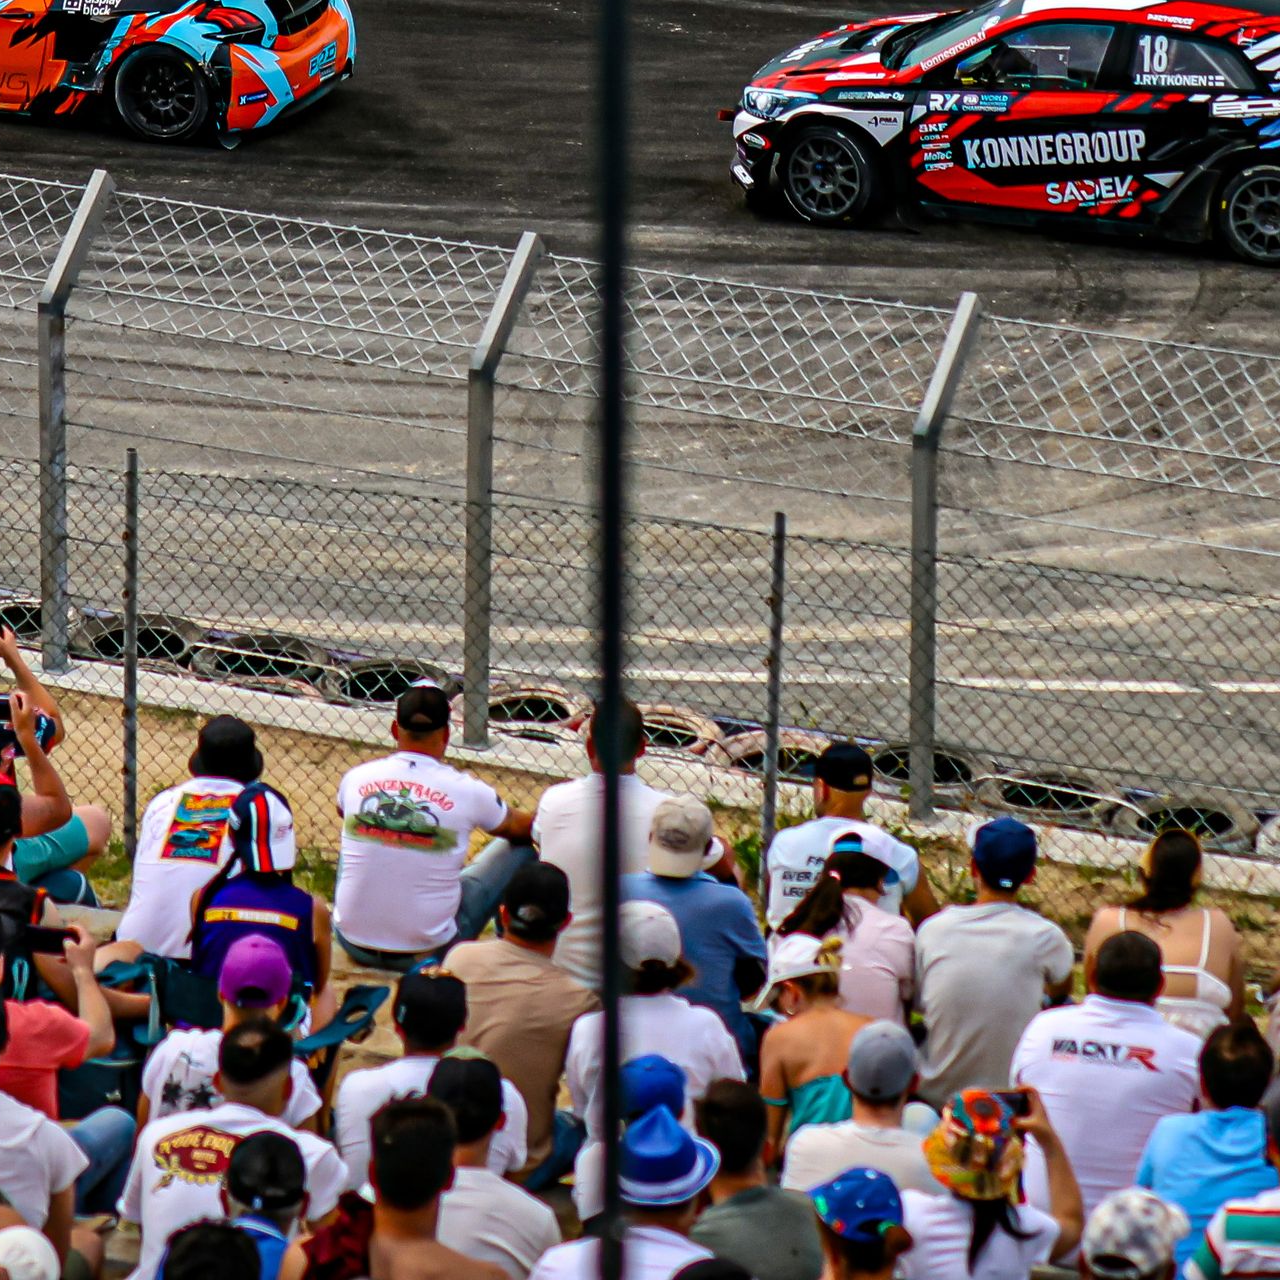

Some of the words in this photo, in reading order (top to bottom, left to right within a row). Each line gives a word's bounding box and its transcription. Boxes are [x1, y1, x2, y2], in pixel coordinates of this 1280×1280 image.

[83, 4, 112, 17] block
[920, 30, 987, 72] konnegroup.fi
[1139, 35, 1169, 74] 18
[929, 93, 959, 112] RX
[980, 94, 1009, 102] WORLD
[962, 129, 1147, 170] KONNEGROUP
